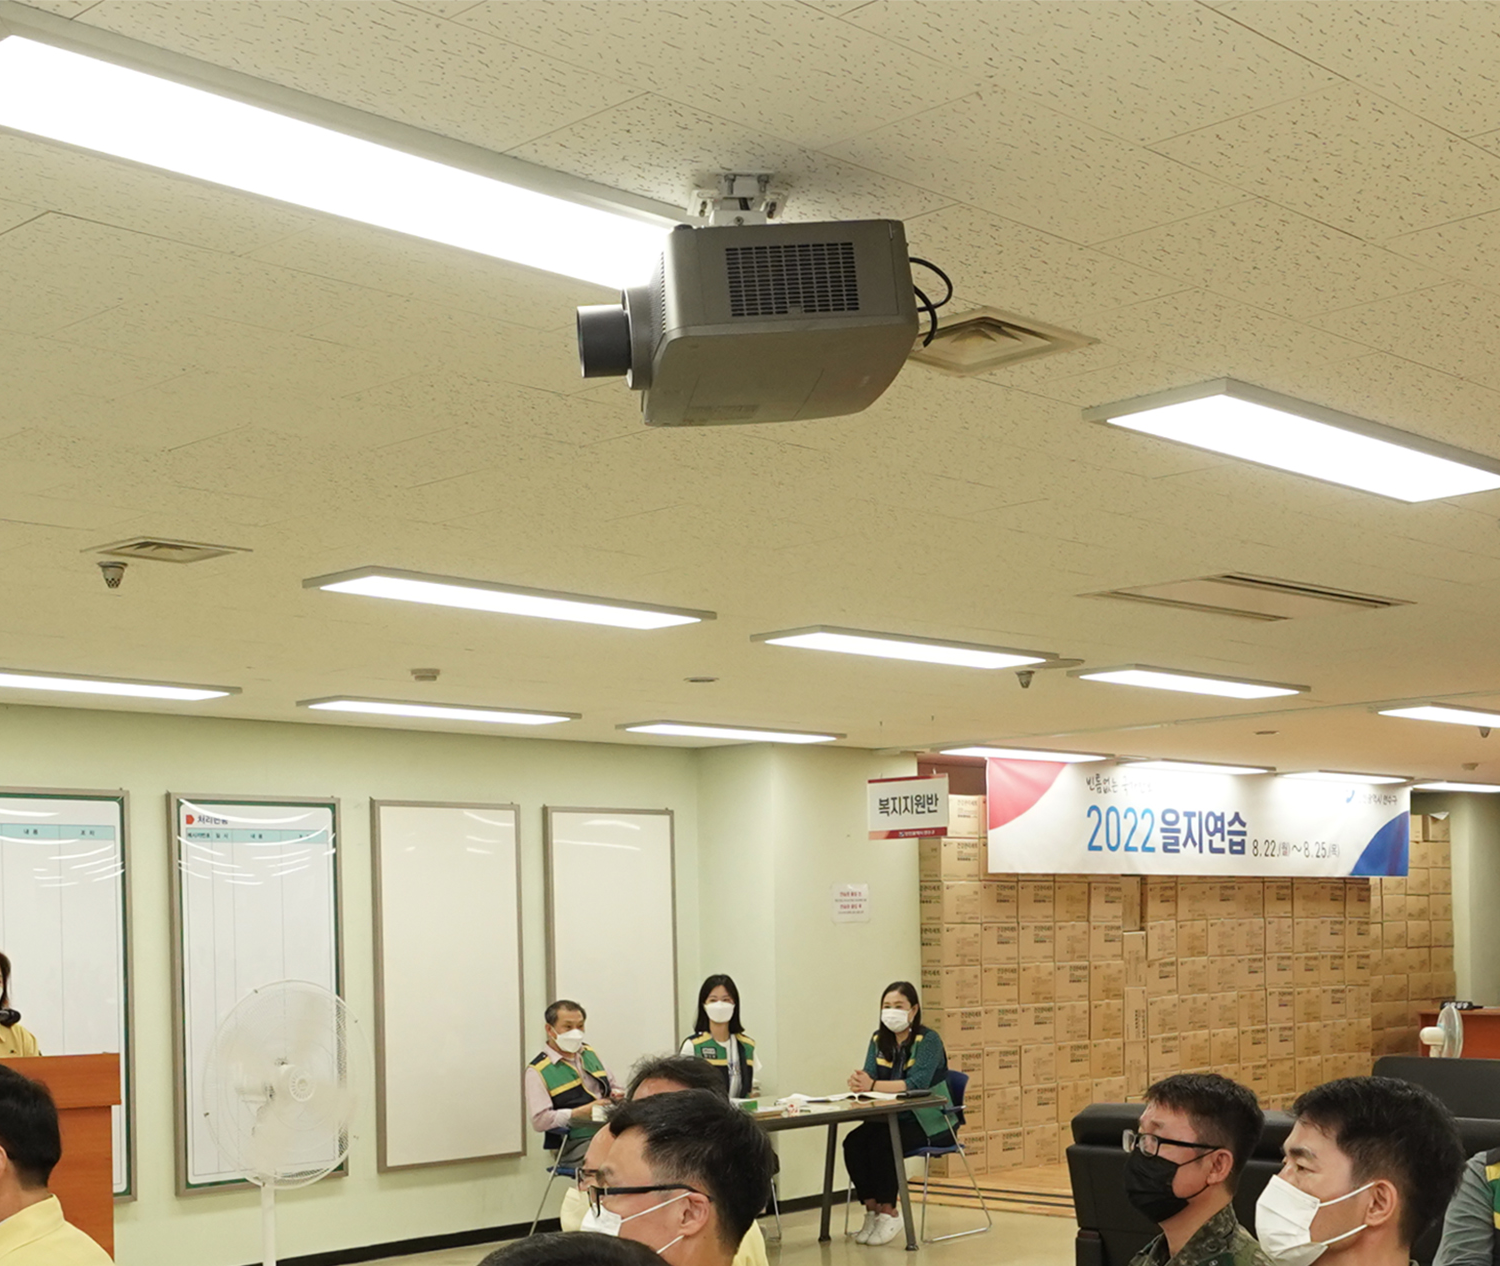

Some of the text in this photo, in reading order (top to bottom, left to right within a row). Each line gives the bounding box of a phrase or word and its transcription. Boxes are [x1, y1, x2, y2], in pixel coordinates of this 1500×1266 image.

[878, 792, 939, 817] 복지지원반
[1086, 804, 1156, 853] 2022
[1159, 808, 1248, 855] 을지연습
